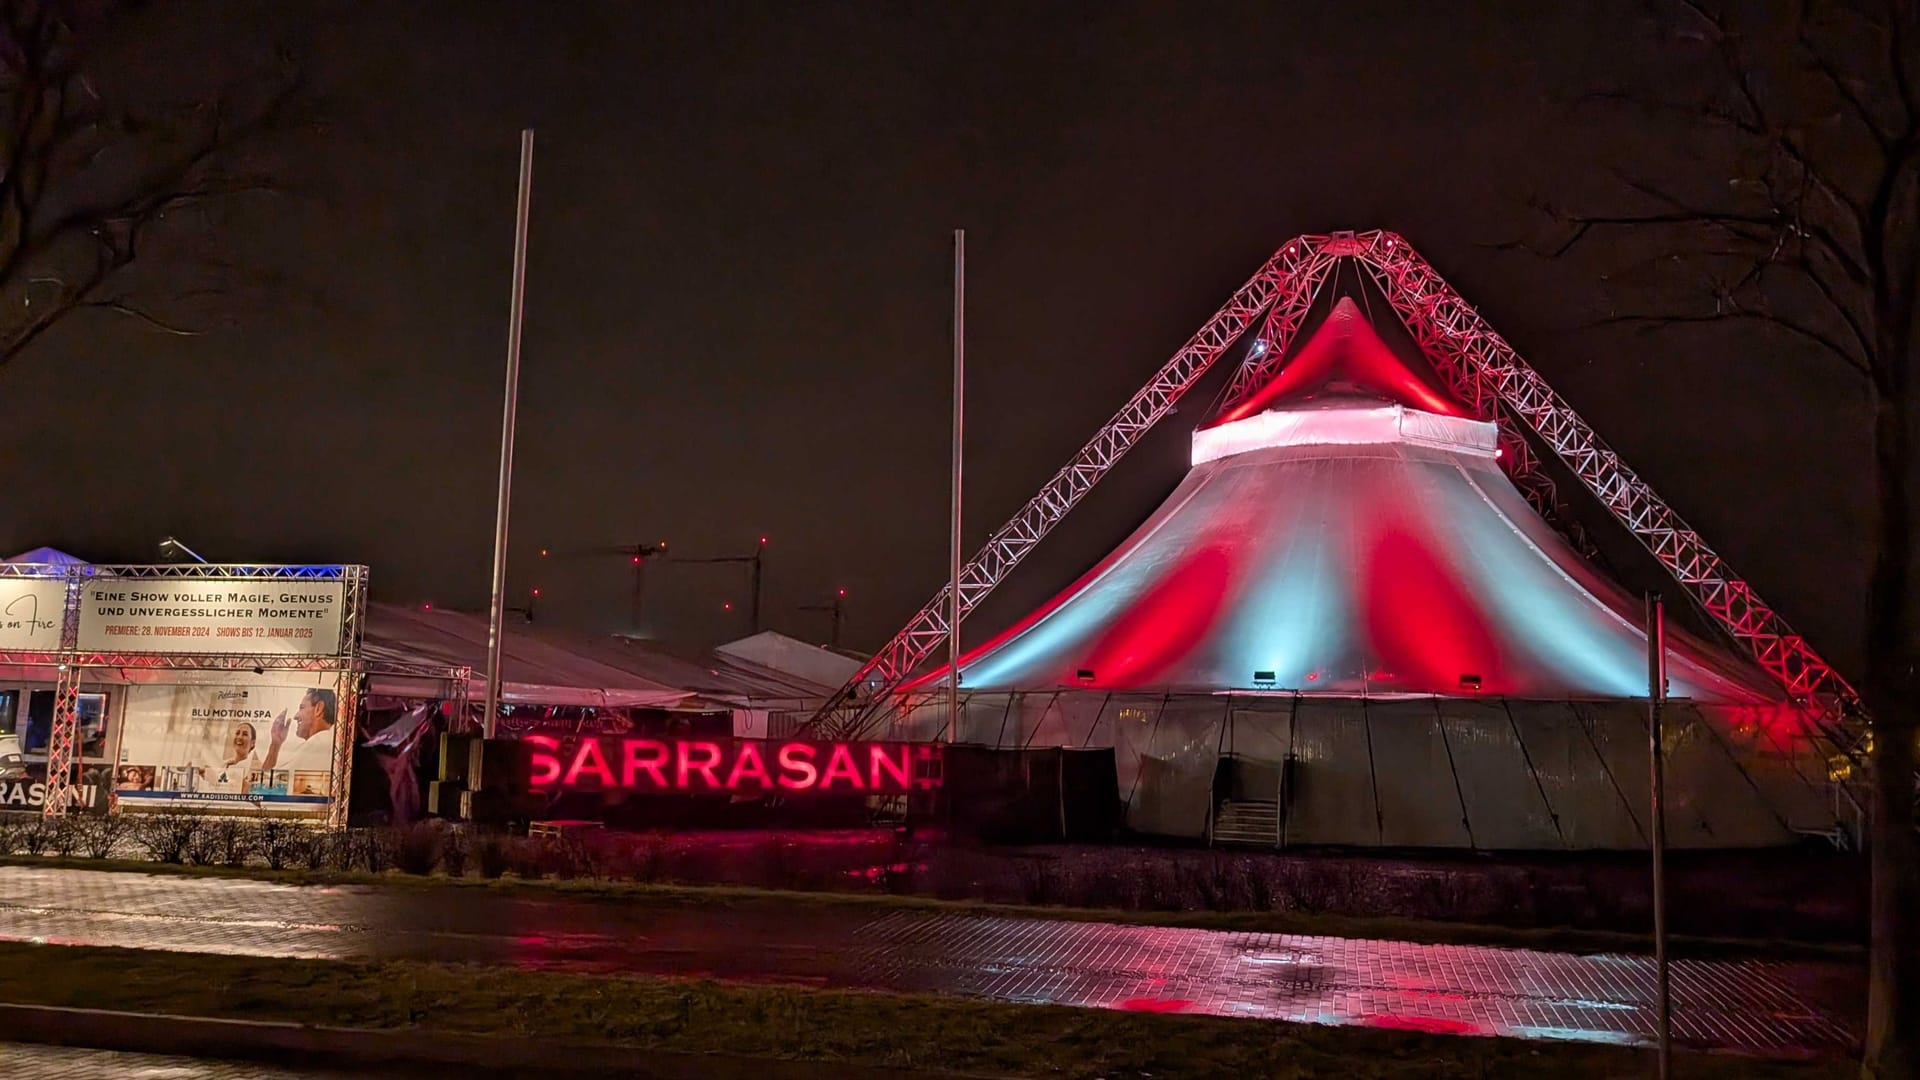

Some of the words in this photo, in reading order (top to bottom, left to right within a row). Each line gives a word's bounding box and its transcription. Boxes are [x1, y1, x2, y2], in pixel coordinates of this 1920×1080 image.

[131, 591, 169, 602] SHOW
[174, 594, 223, 602] VOLLER
[228, 593, 274, 604] MAGIE,
[280, 593, 333, 603] GENUSS
[98, 607, 125, 616] UND
[129, 607, 253, 618] UNVERGESSLICHER
[7, 621, 20, 629] on
[105, 625, 140, 636] PREMIERE:
[141, 626, 153, 636] 28.
[154, 626, 190, 637] NOVEMBER
[191, 627, 210, 637] 2024
[216, 627, 240, 637] SHOWS
[242, 627, 253, 637] BIS
[255, 628, 266, 638] 12.
[267, 628, 293, 638] JANUAR
[294, 628, 313, 638] 2025
[192, 708, 210, 717] BLU
[212, 709, 251, 718] MOTION
[253, 710, 271, 718] SPA
